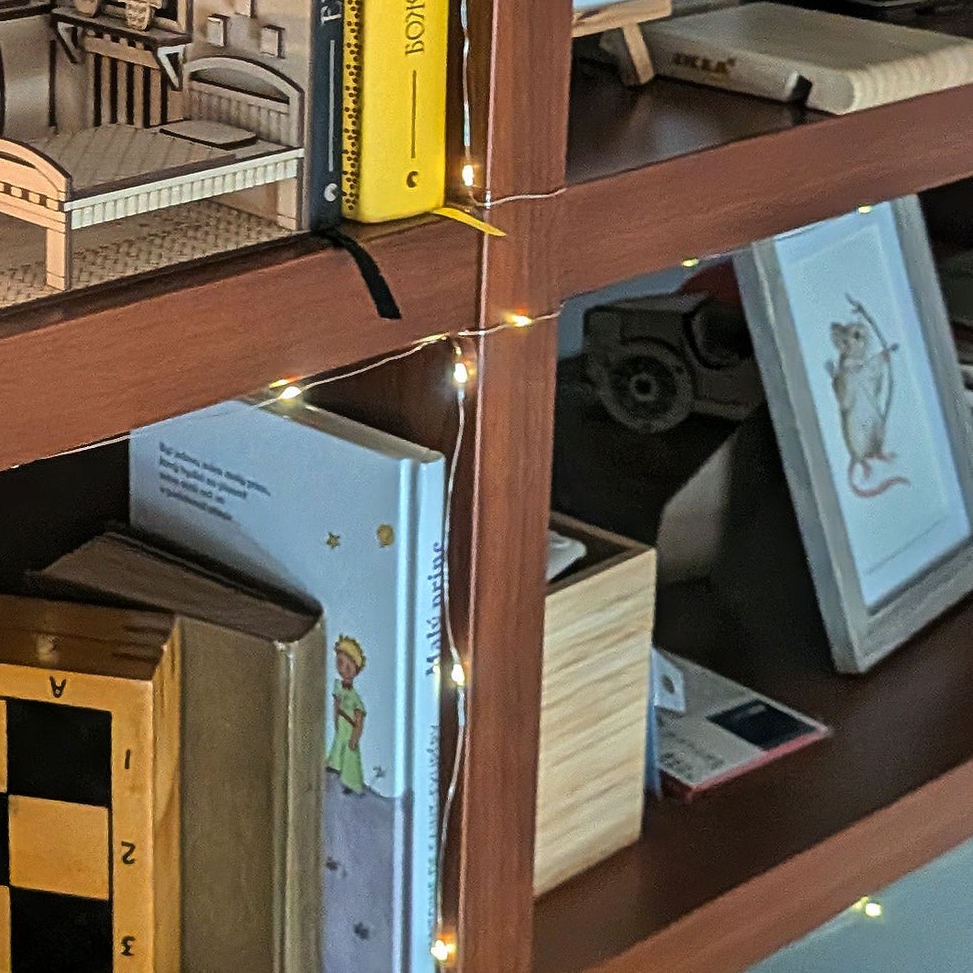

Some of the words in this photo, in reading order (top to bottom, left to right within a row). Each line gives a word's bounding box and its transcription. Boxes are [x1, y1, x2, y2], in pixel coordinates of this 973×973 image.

[49, 676, 67, 698] A
[120, 841, 136, 865] 2
[121, 935, 136, 957] 3
